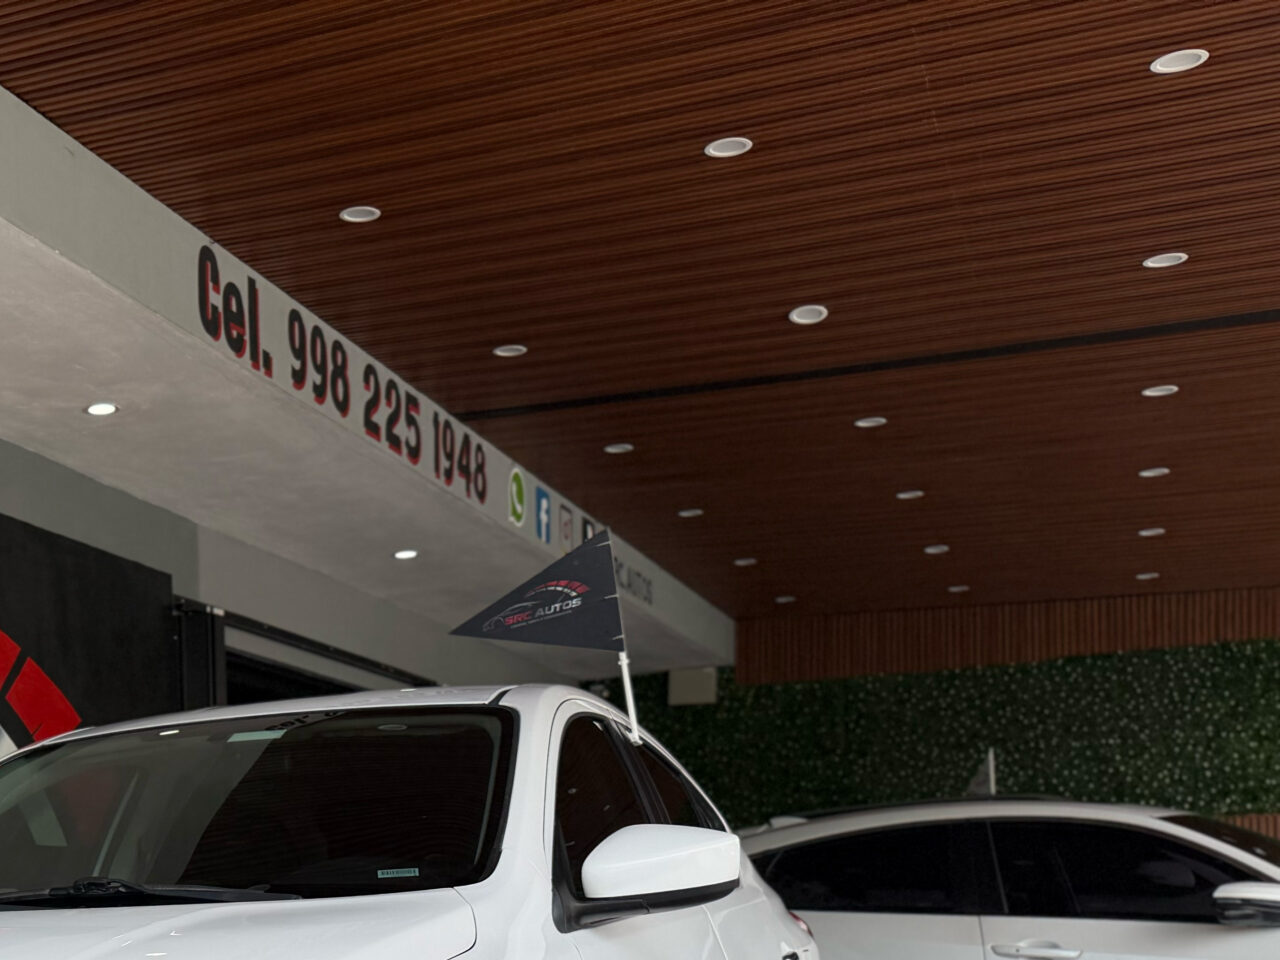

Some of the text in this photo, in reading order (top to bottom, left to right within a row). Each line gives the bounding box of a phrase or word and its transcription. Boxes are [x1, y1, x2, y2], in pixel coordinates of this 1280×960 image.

[198, 245, 487, 505] Cel. 998 225 1948
[504, 610, 533, 626] SRC
[534, 597, 583, 618] AUTOS
